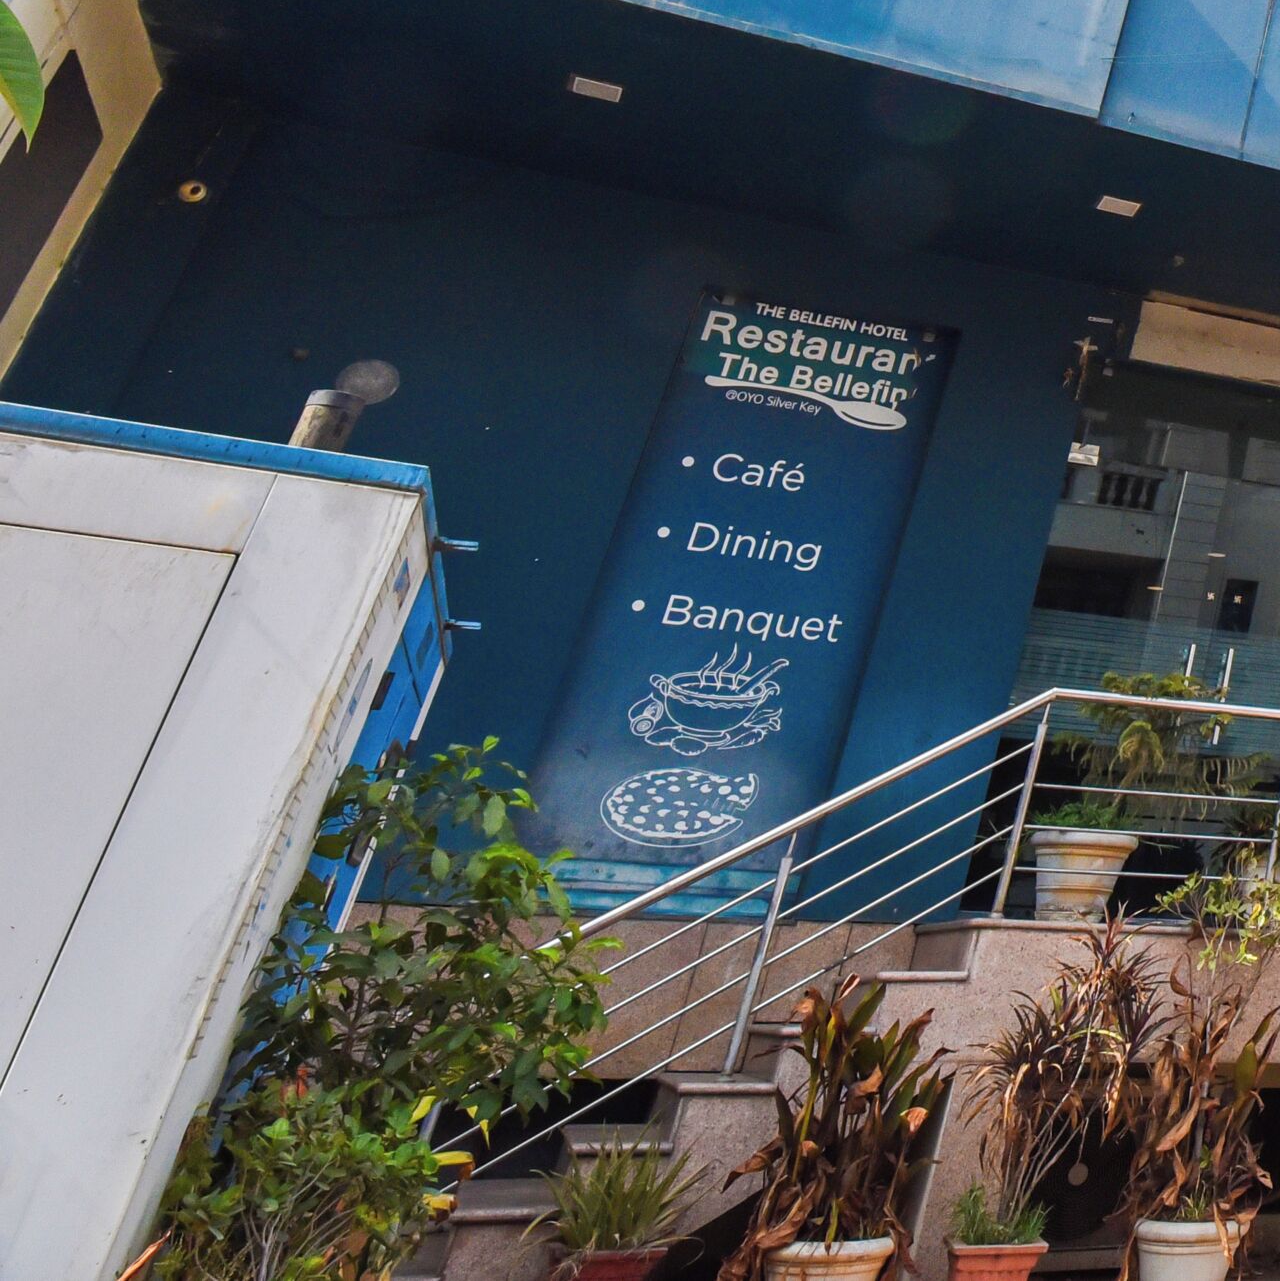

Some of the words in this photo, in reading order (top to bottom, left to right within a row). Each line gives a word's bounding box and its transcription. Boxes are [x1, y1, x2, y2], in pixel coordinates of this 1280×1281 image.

[755, 302, 787, 319] THE
[789, 308, 858, 332] BELLEFIN
[860, 321, 908, 342] HOTEL
[719, 351, 780, 385] The
[725, 389, 765, 405] @OYO
[766, 395, 797, 410] Silver
[799, 400, 822, 416] Key
[713, 453, 806, 492] Café
[686, 521, 822, 572] Dining
[661, 594, 843, 643] Banquet
